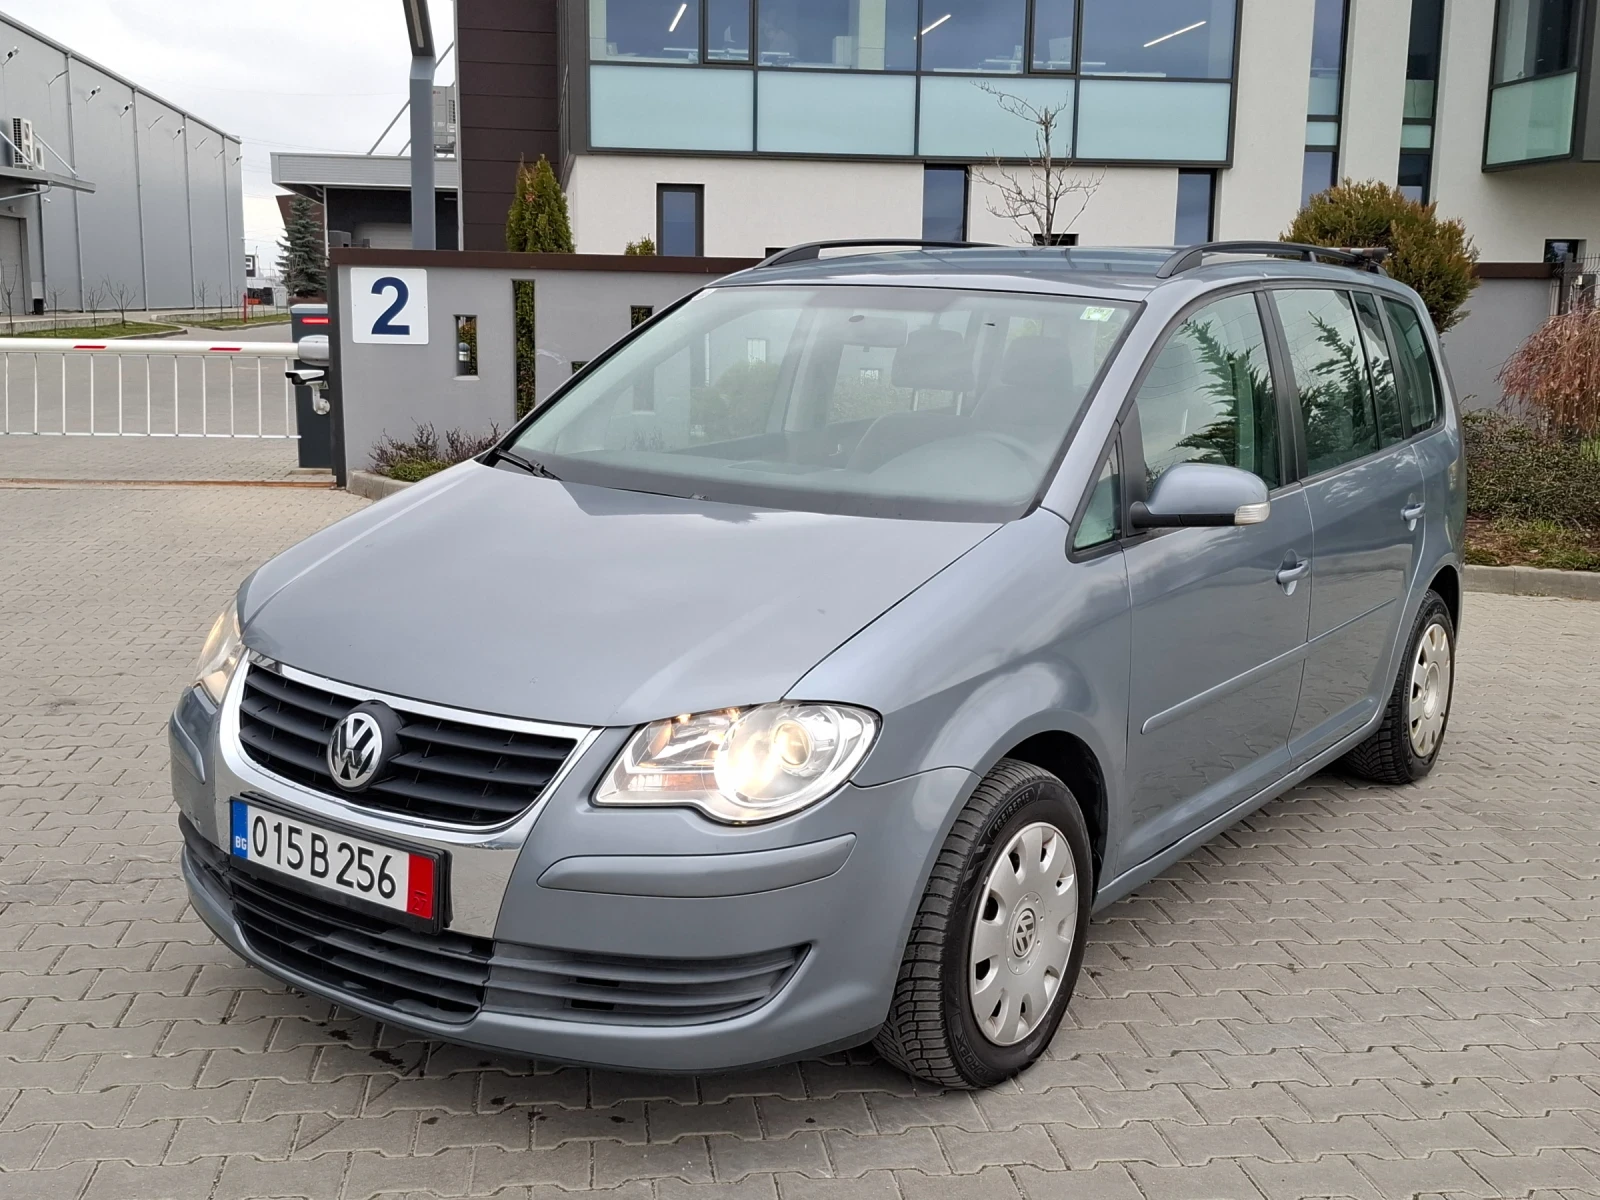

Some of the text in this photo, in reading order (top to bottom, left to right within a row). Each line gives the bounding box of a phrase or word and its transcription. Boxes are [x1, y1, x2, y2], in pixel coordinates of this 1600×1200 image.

[371, 276, 410, 336] 2
[235, 835, 247, 851] BG
[253, 815, 396, 899] 015B256
